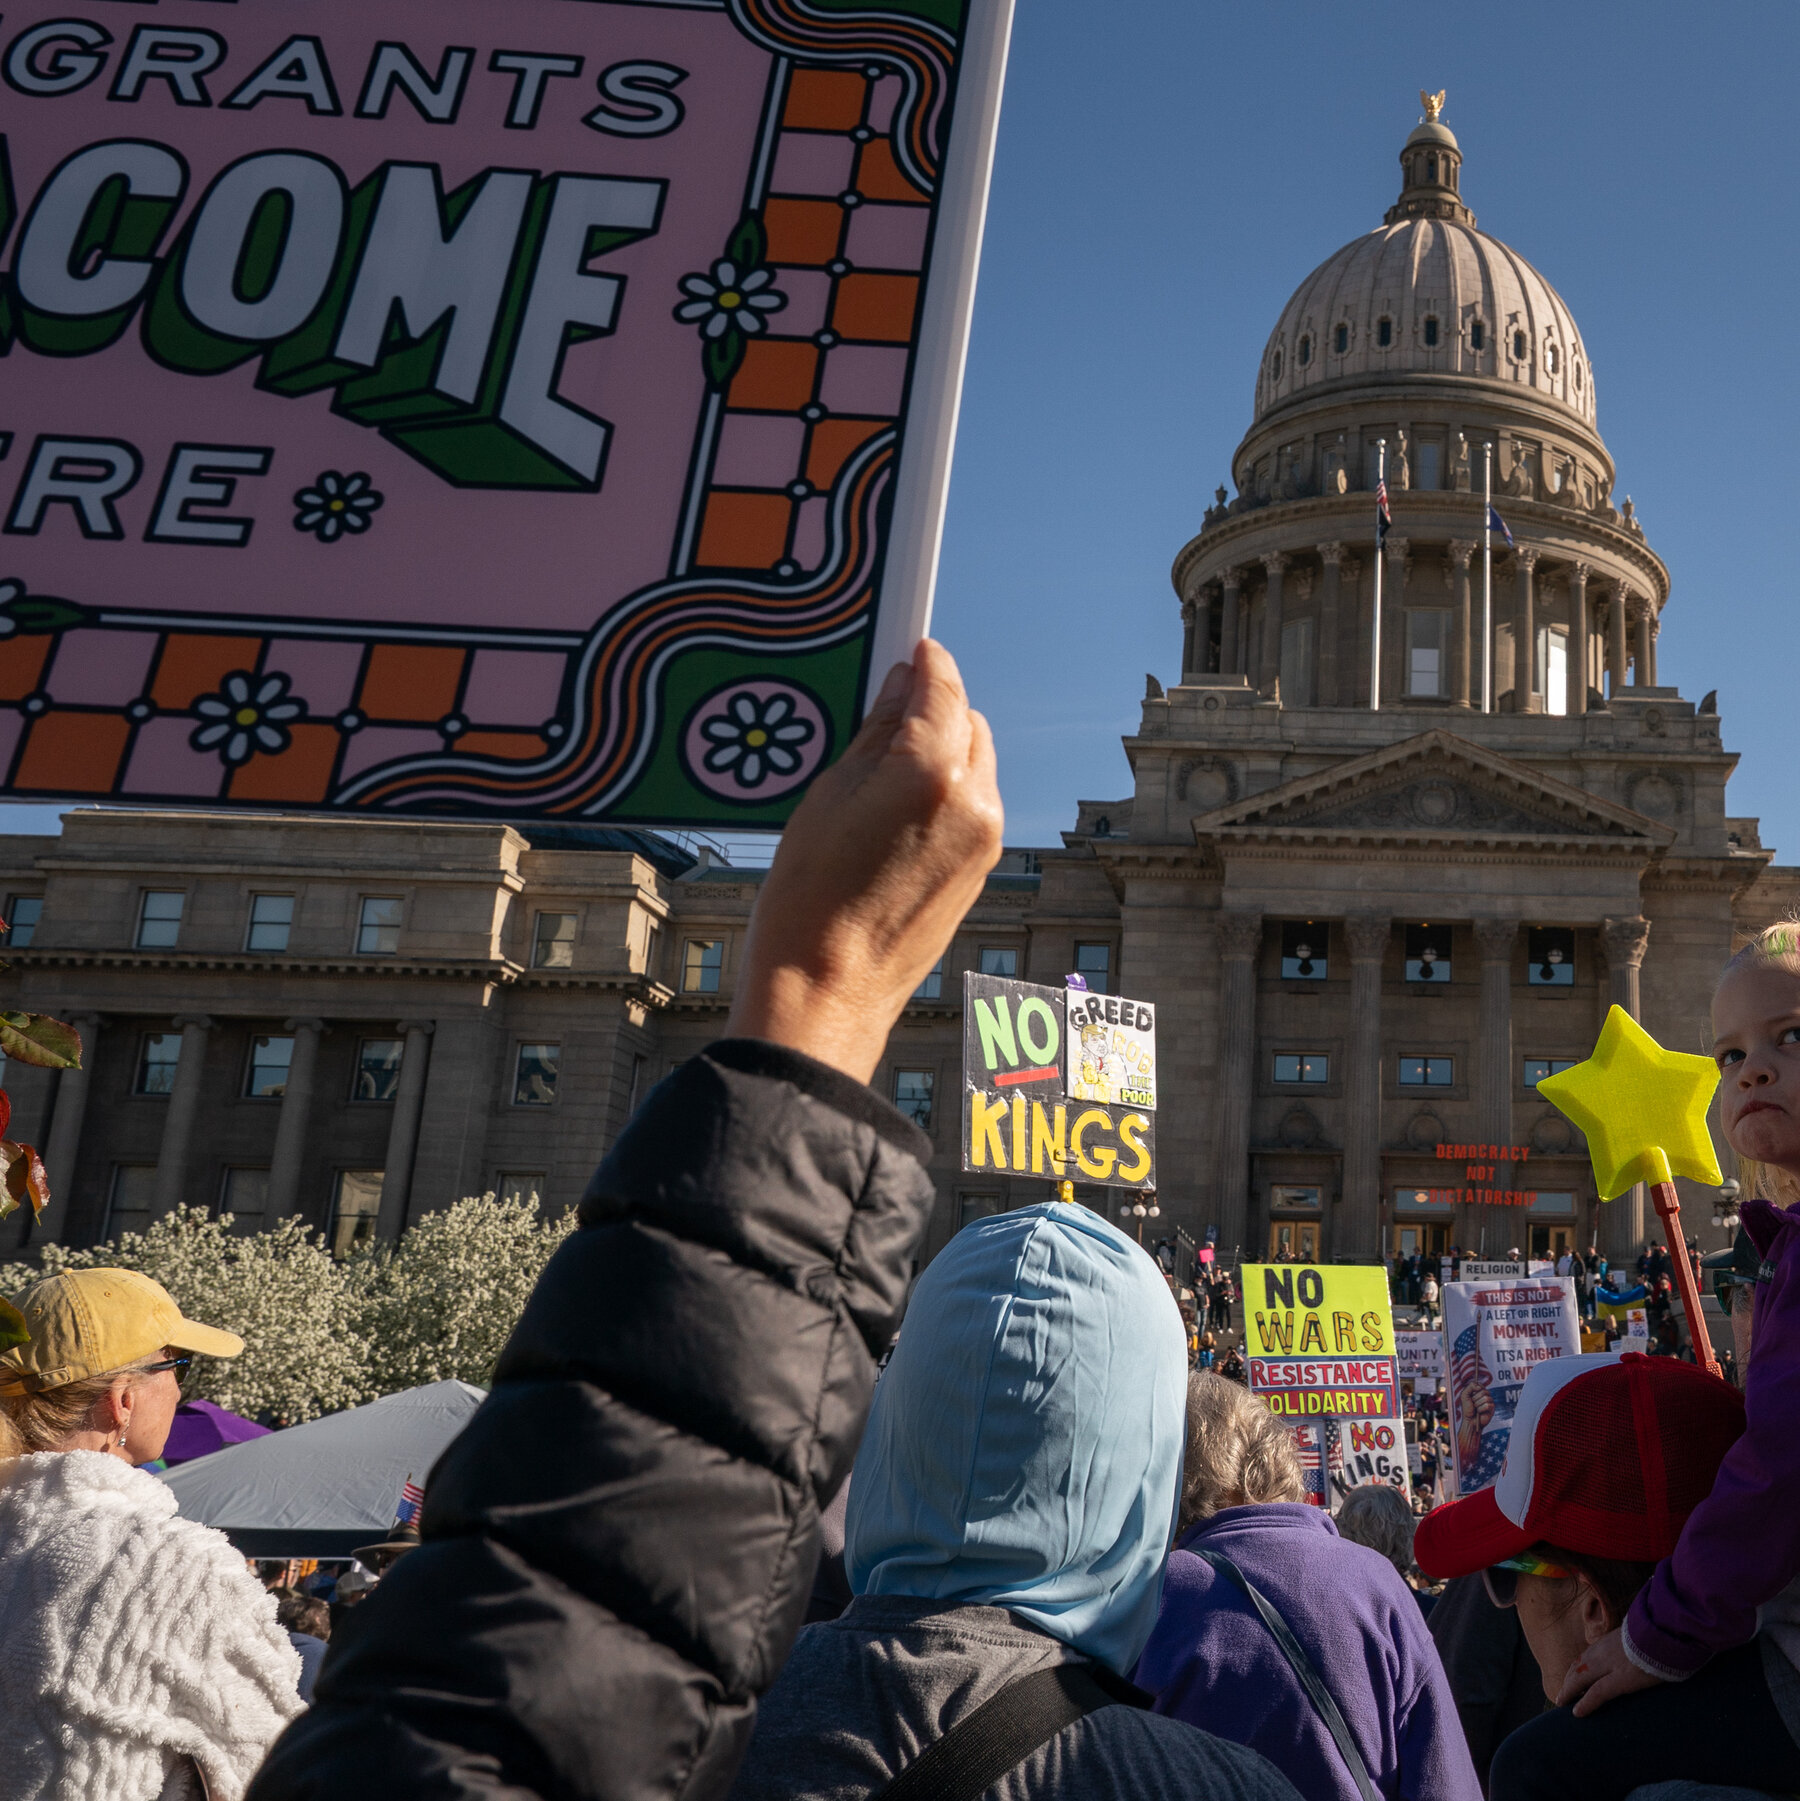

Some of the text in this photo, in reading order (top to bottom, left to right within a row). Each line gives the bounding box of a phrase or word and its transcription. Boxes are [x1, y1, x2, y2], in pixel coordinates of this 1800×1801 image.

[0, 431, 274, 548] RE
[1069, 996, 1153, 1032] GREED
[973, 995, 1060, 1070] NO
[1112, 1030, 1153, 1074] ROB
[971, 1091, 1152, 1182] KINGS
[1436, 1143, 1530, 1162] DEMOCRACY
[1466, 1165, 1495, 1181] NOT
[1429, 1188, 1538, 1207] DICTATORSHIP
[1466, 1264, 1519, 1275] RELIGION
[1264, 1268, 1324, 1309] NO
[1485, 1289, 1552, 1303] THIS IS NOT
[1486, 1306, 1561, 1320] A LEFT OR RIGHT
[1255, 1311, 1383, 1355] WARS
[1493, 1322, 1559, 1339] MOMENT,
[1515, 1349, 1523, 1361] A
[1525, 1347, 1562, 1361] RIGHT
[1250, 1360, 1391, 1386] RESISTANCE
[1498, 1370, 1511, 1380] OR
[1350, 1421, 1395, 1452] NO
[1330, 1453, 1404, 1499] KINGS
